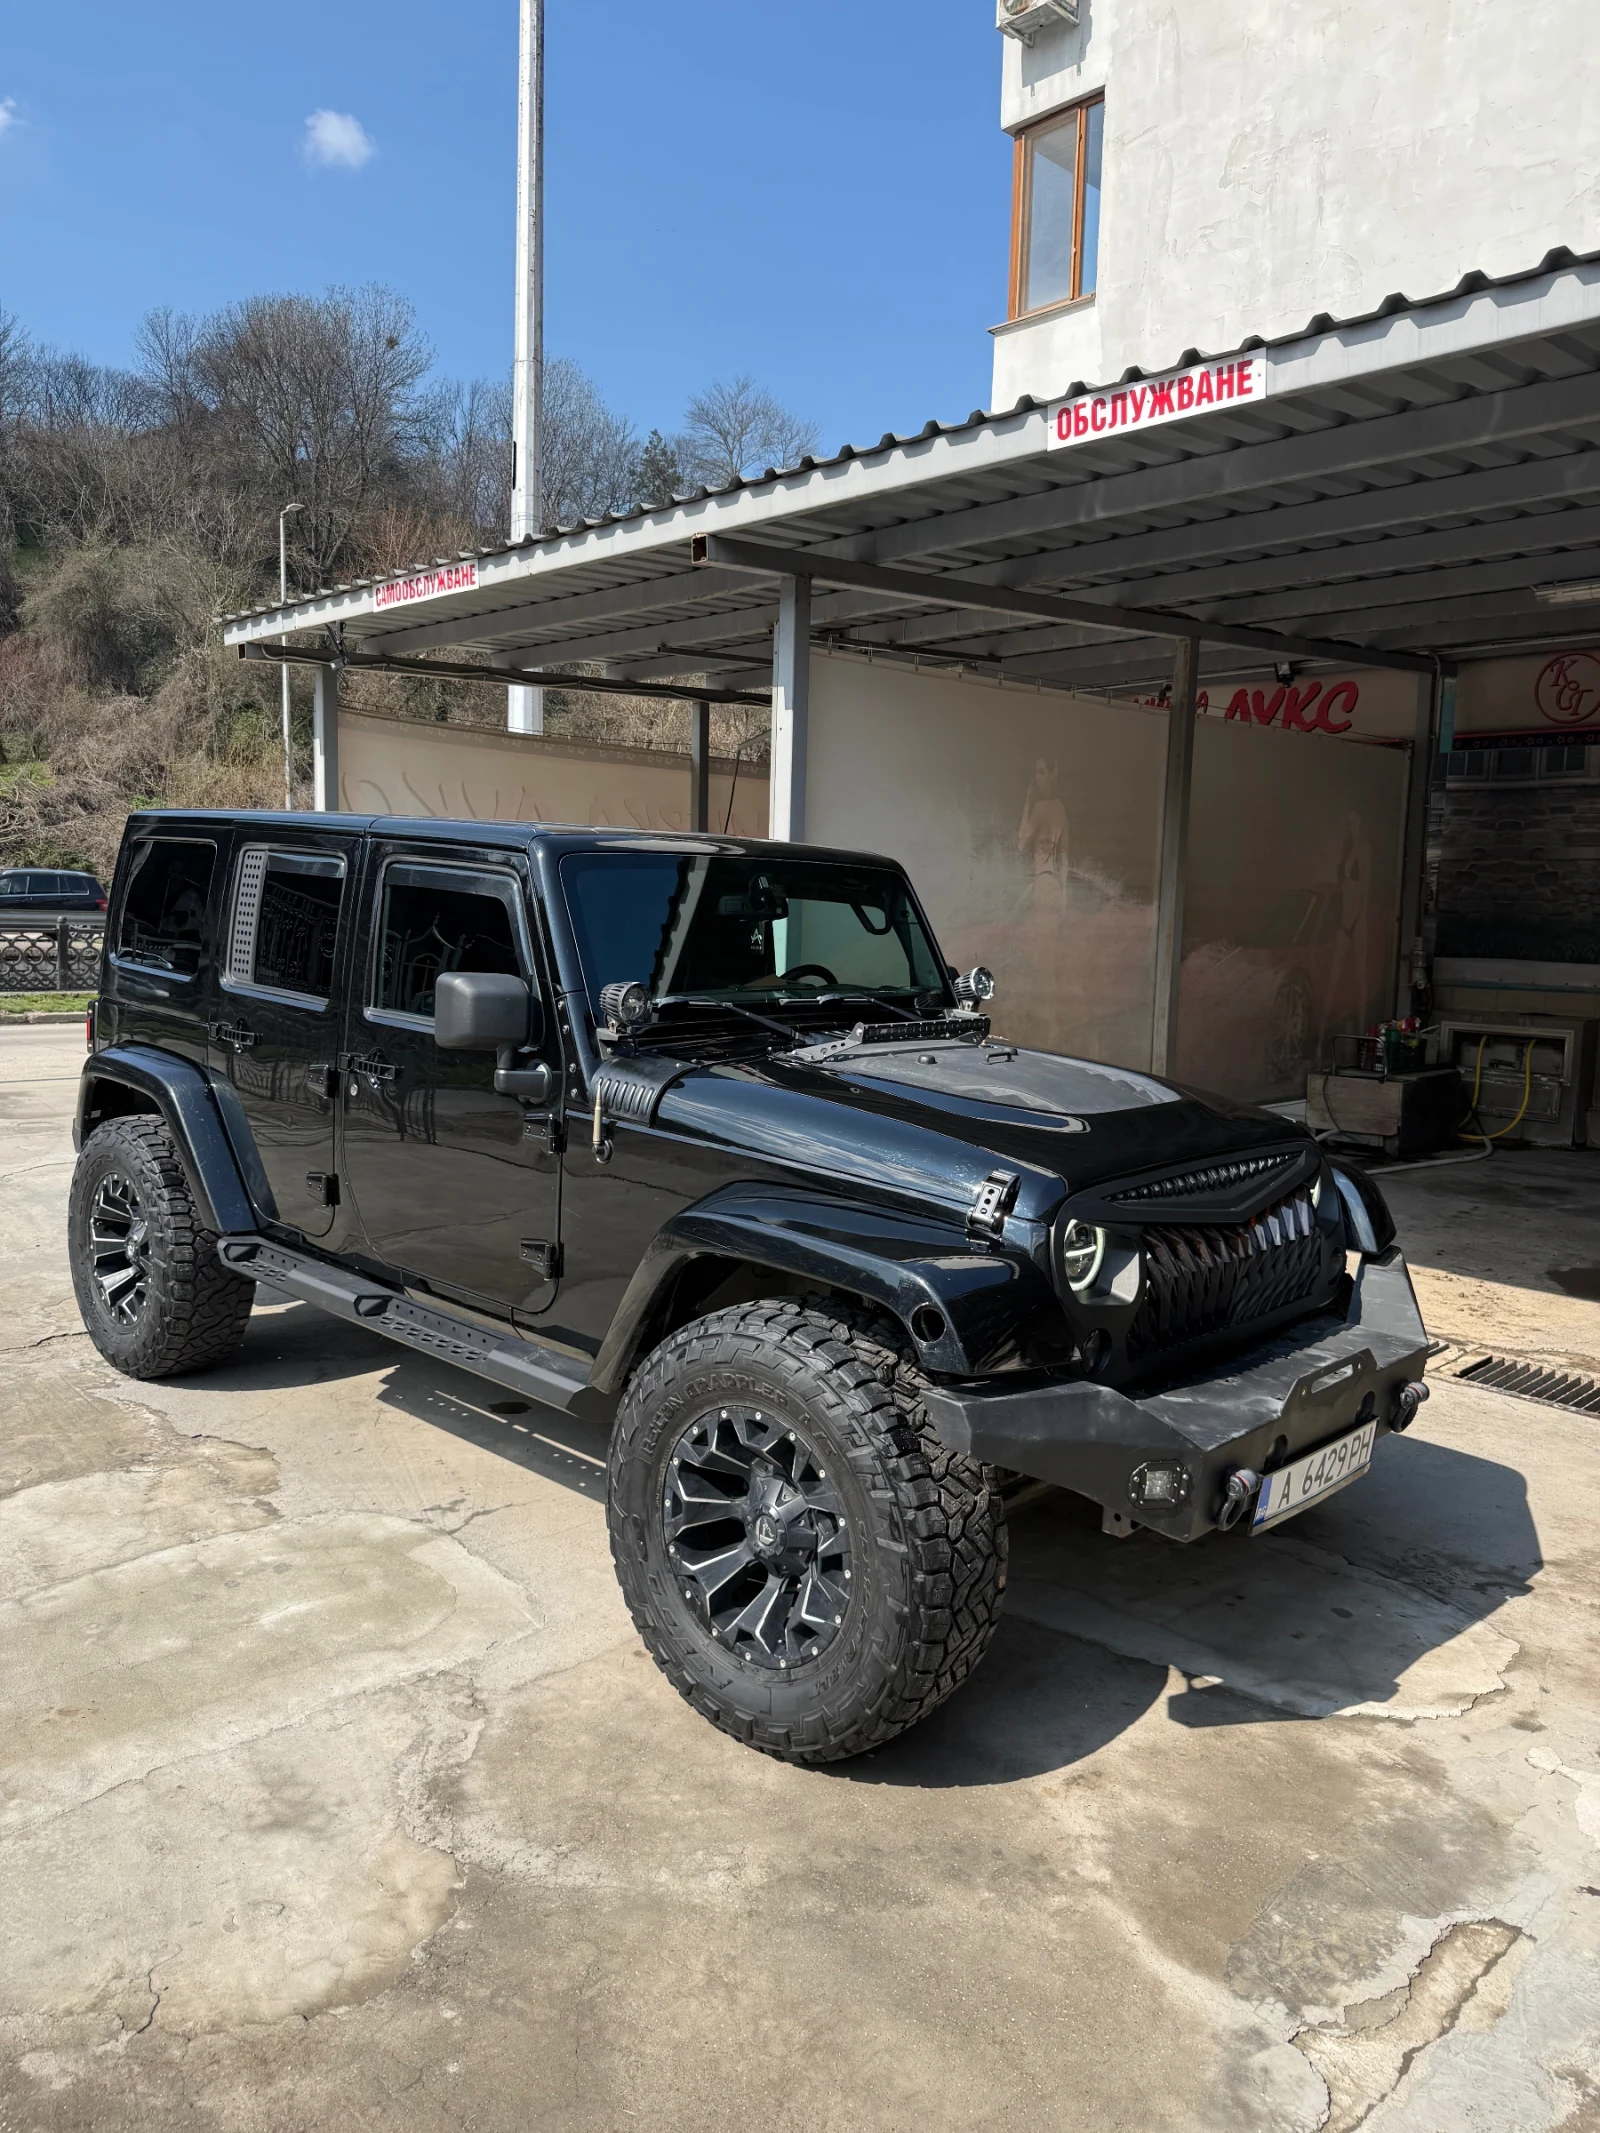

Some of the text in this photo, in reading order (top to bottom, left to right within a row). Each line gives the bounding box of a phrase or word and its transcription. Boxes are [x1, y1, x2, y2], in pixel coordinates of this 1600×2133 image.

[1057, 359, 1254, 441] ОБСЛУЖВАНЕ
[375, 564, 476, 607] САМООБСЛУЖВАНЕ
[1225, 680, 1359, 734] ЛУКС
[641, 1393, 685, 1455] RECON
[1277, 1427, 1374, 1509] A 6429 PH
